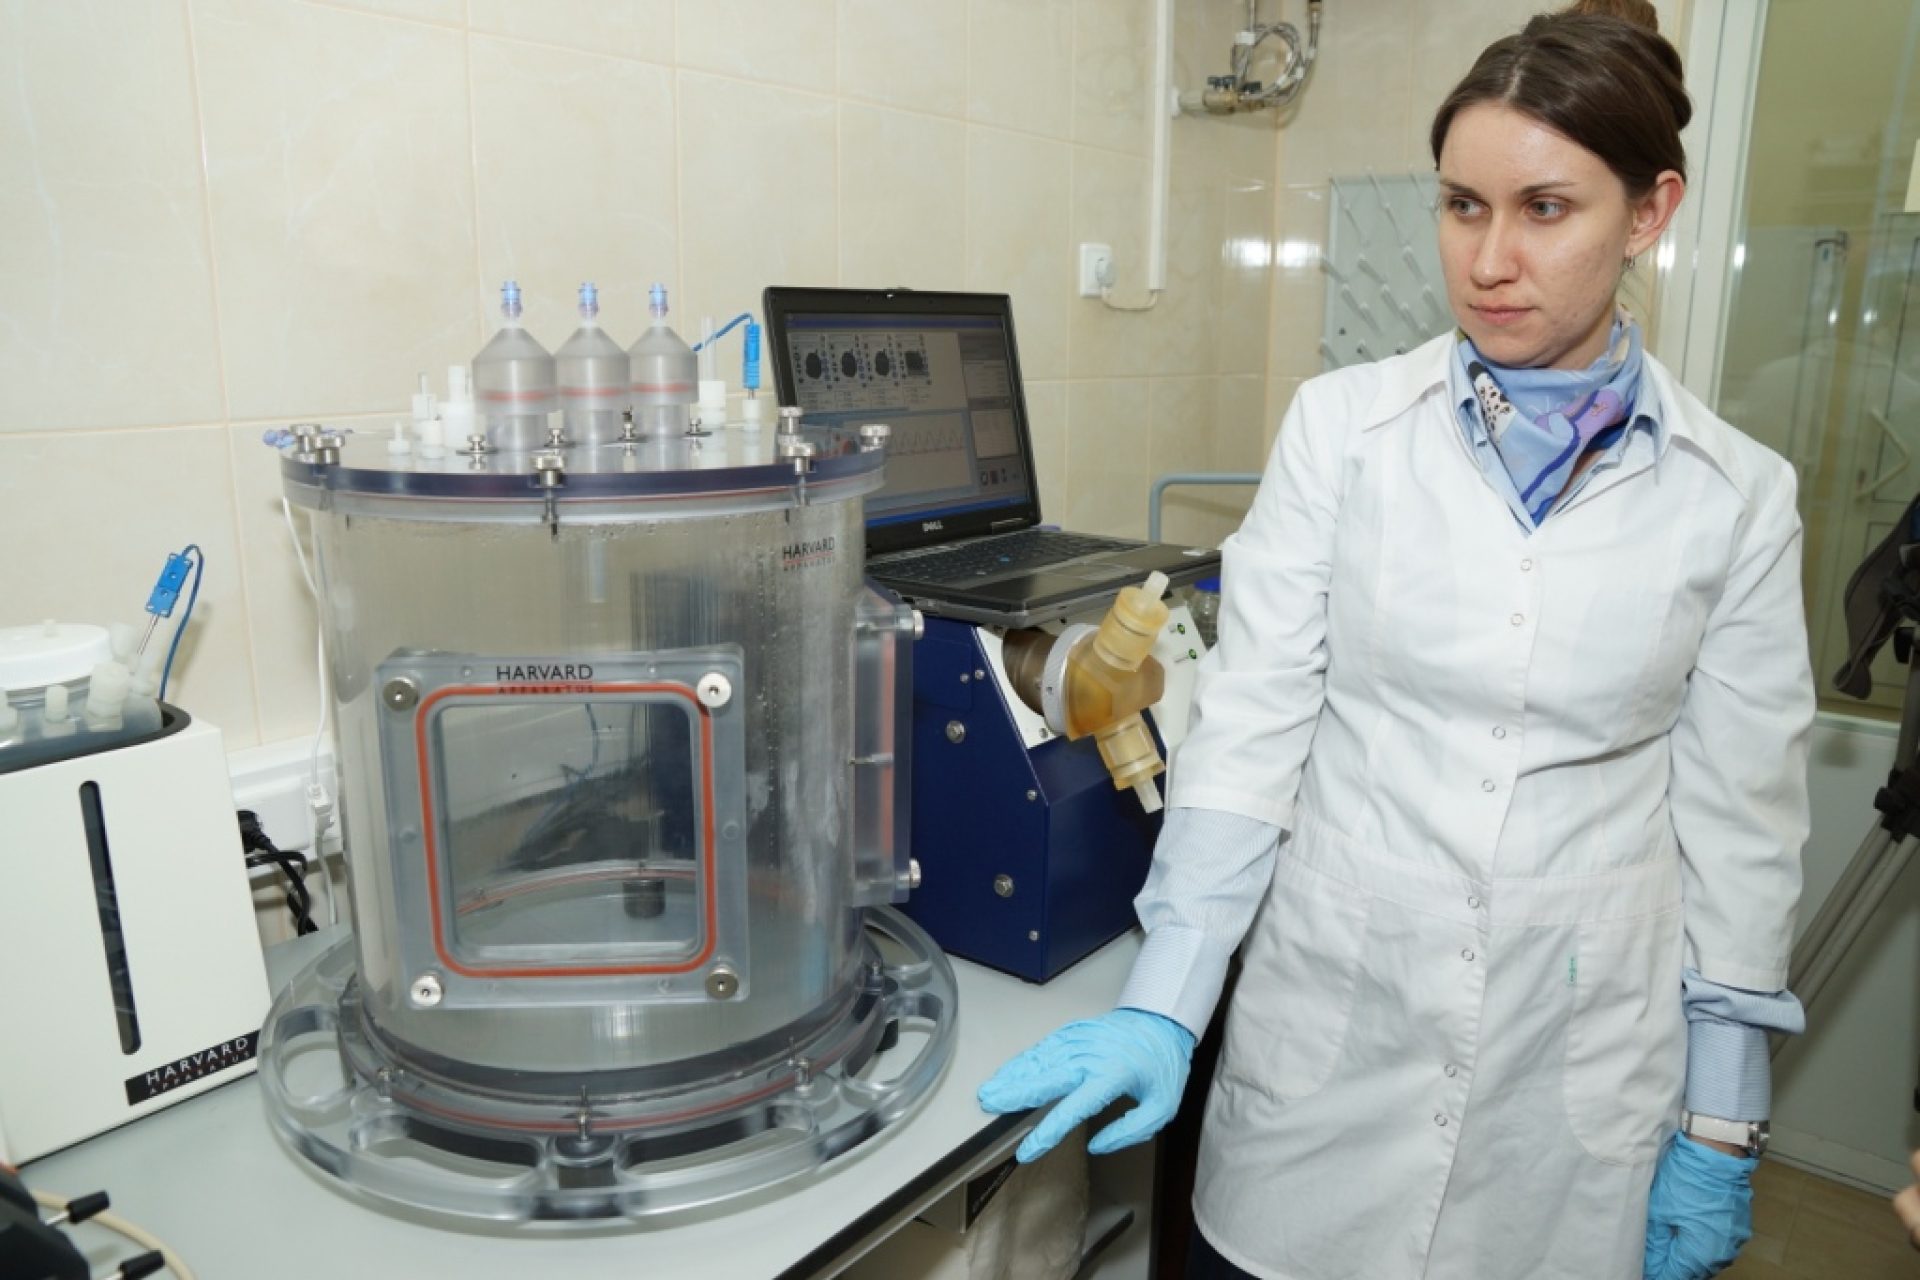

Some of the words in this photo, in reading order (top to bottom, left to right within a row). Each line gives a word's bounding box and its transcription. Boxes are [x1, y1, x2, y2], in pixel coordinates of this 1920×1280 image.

[782, 536, 835, 561] HARVARD
[496, 664, 593, 681] HARVARD
[145, 1036, 249, 1086] HARVARD
